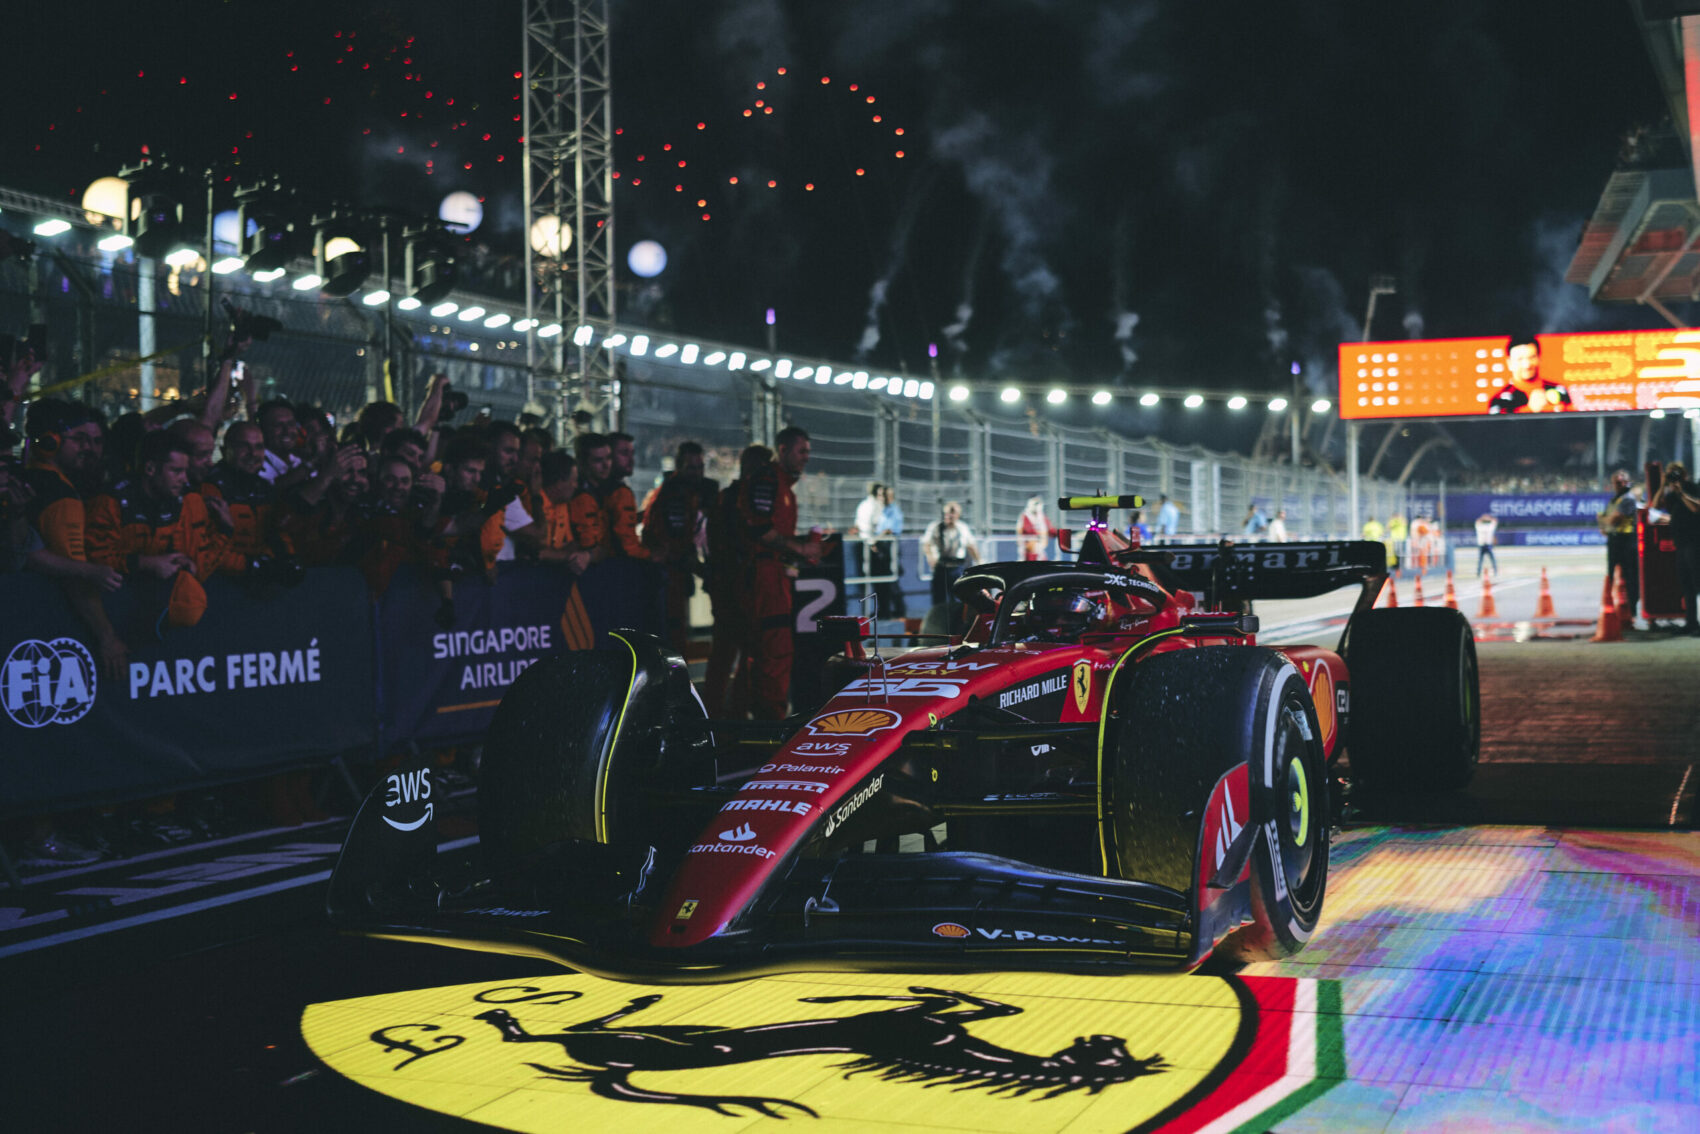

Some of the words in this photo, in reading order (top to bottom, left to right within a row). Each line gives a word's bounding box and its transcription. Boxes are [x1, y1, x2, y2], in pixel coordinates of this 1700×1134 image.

[1489, 500, 1573, 517] SINGAPORE
[1169, 546, 1345, 571] errari
[1103, 572, 1128, 587] DXC
[794, 578, 837, 634] 2
[432, 624, 552, 659] SINGAPORE
[128, 655, 216, 700] PARC
[226, 636, 321, 690] FERMÉ
[883, 660, 999, 672] VGW
[886, 668, 961, 676] PLAY
[834, 678, 970, 699] 55
[998, 681, 1040, 710] RICHARD
[1040, 673, 1068, 696] MILLE
[795, 741, 853, 752] aws
[775, 762, 846, 775] Palantir
[384, 766, 432, 808] aws
[738, 779, 830, 794] PIRELLI
[719, 799, 813, 817] MAHLE
[835, 772, 885, 829] Santander
[975, 926, 1127, 946] V-Power
